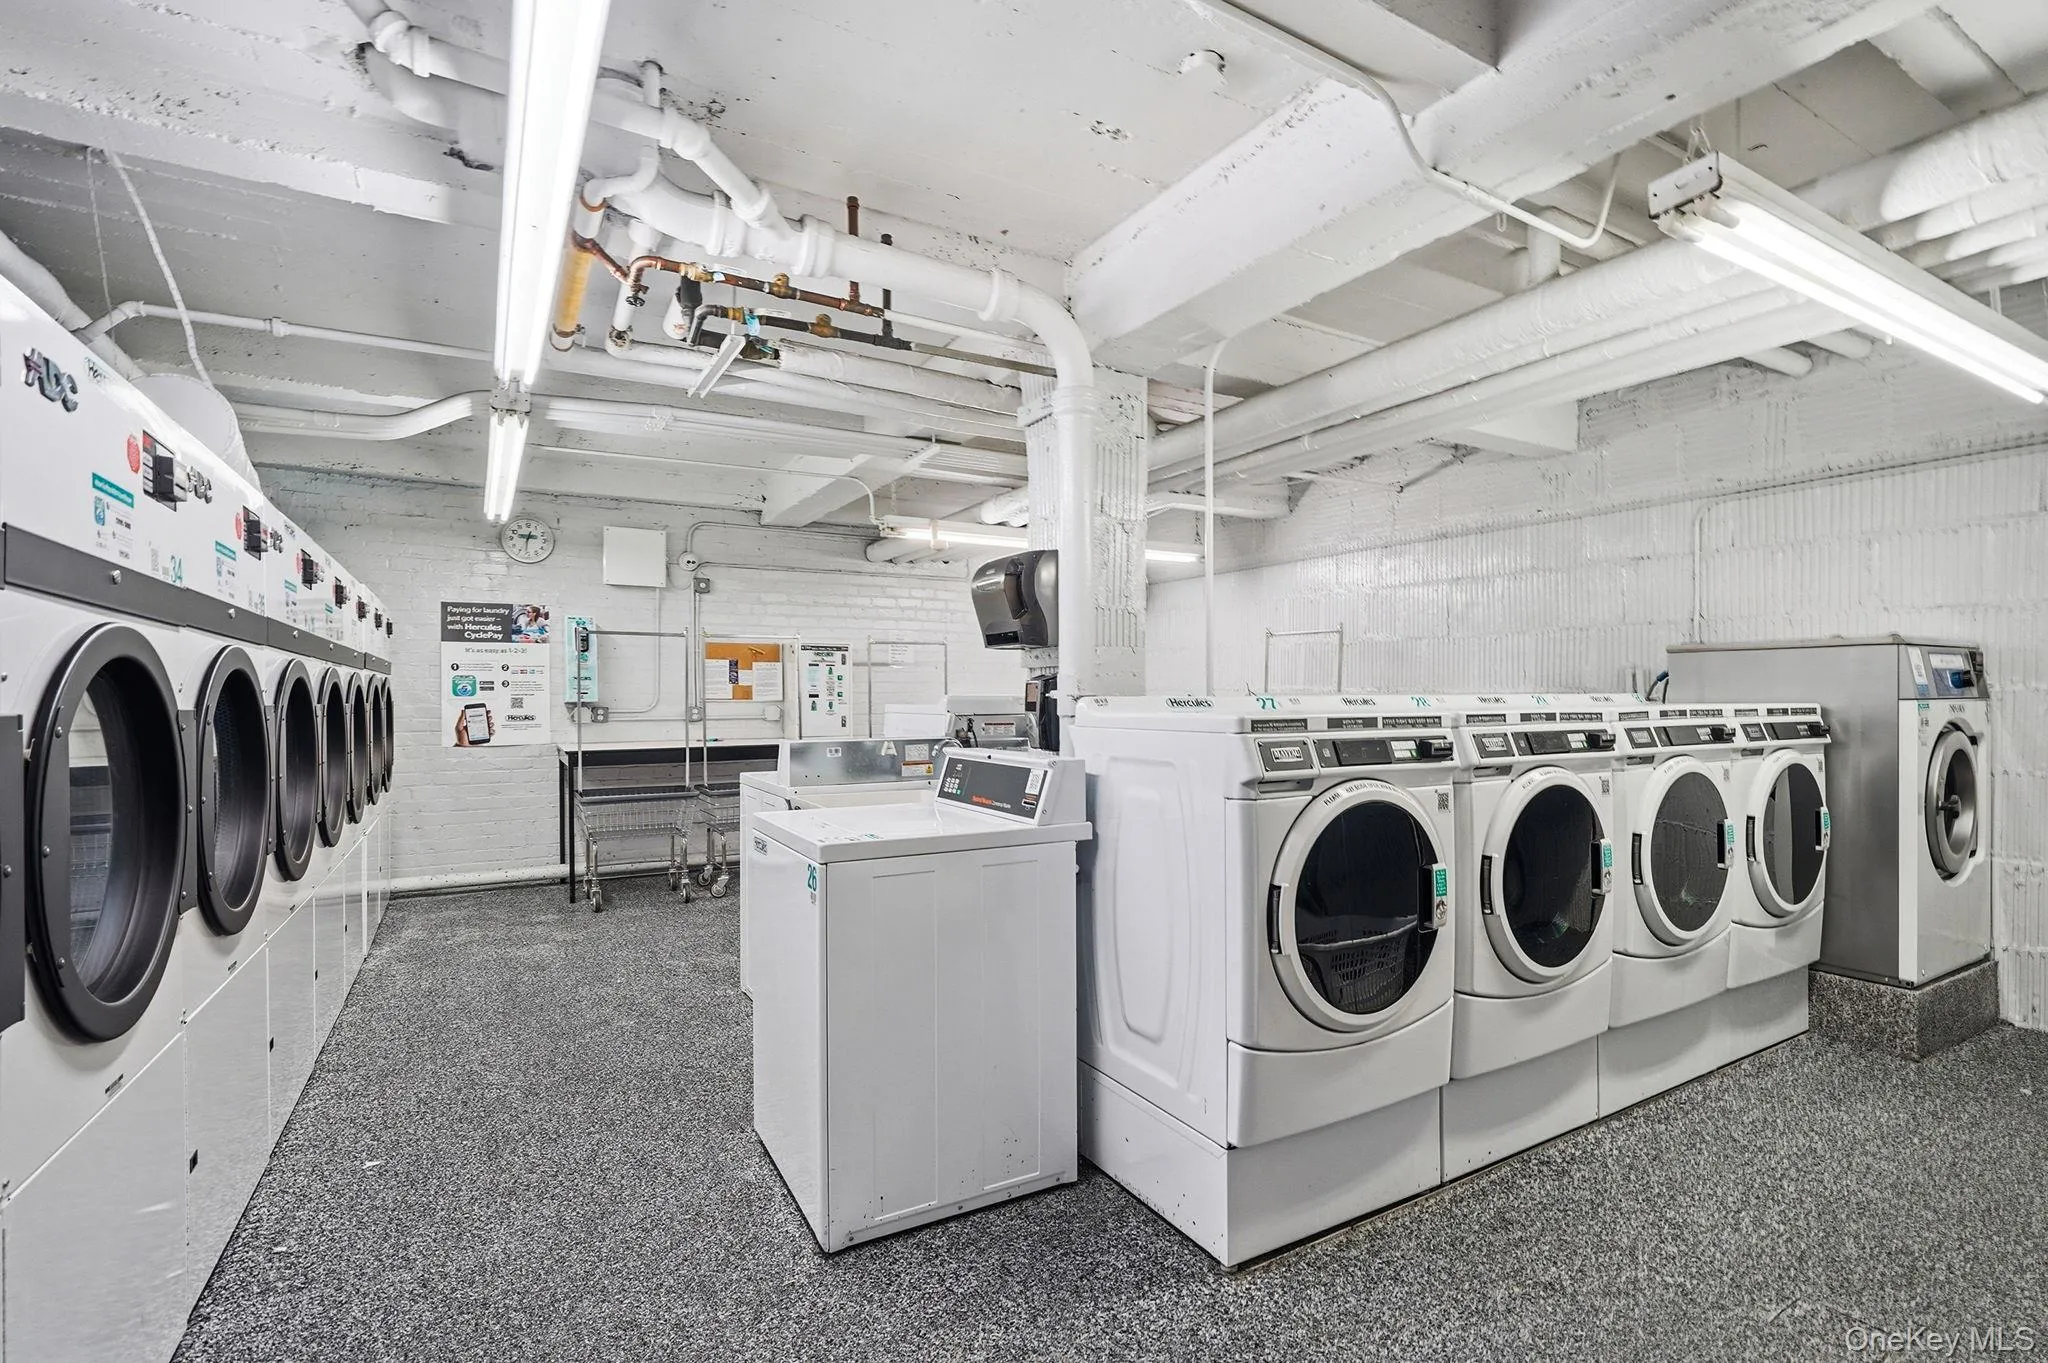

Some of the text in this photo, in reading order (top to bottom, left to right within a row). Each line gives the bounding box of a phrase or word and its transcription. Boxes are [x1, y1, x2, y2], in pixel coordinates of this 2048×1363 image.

[170, 554, 183, 584] 34
[447, 605, 471, 614] Paying
[483, 607, 509, 615] laundry
[446, 614, 460, 622] just
[464, 623, 502, 631] Hercules
[464, 631, 503, 640] CyclePay
[1168, 698, 1212, 708] Hercules
[1256, 697, 1277, 710] 27
[807, 863, 818, 892] 26
